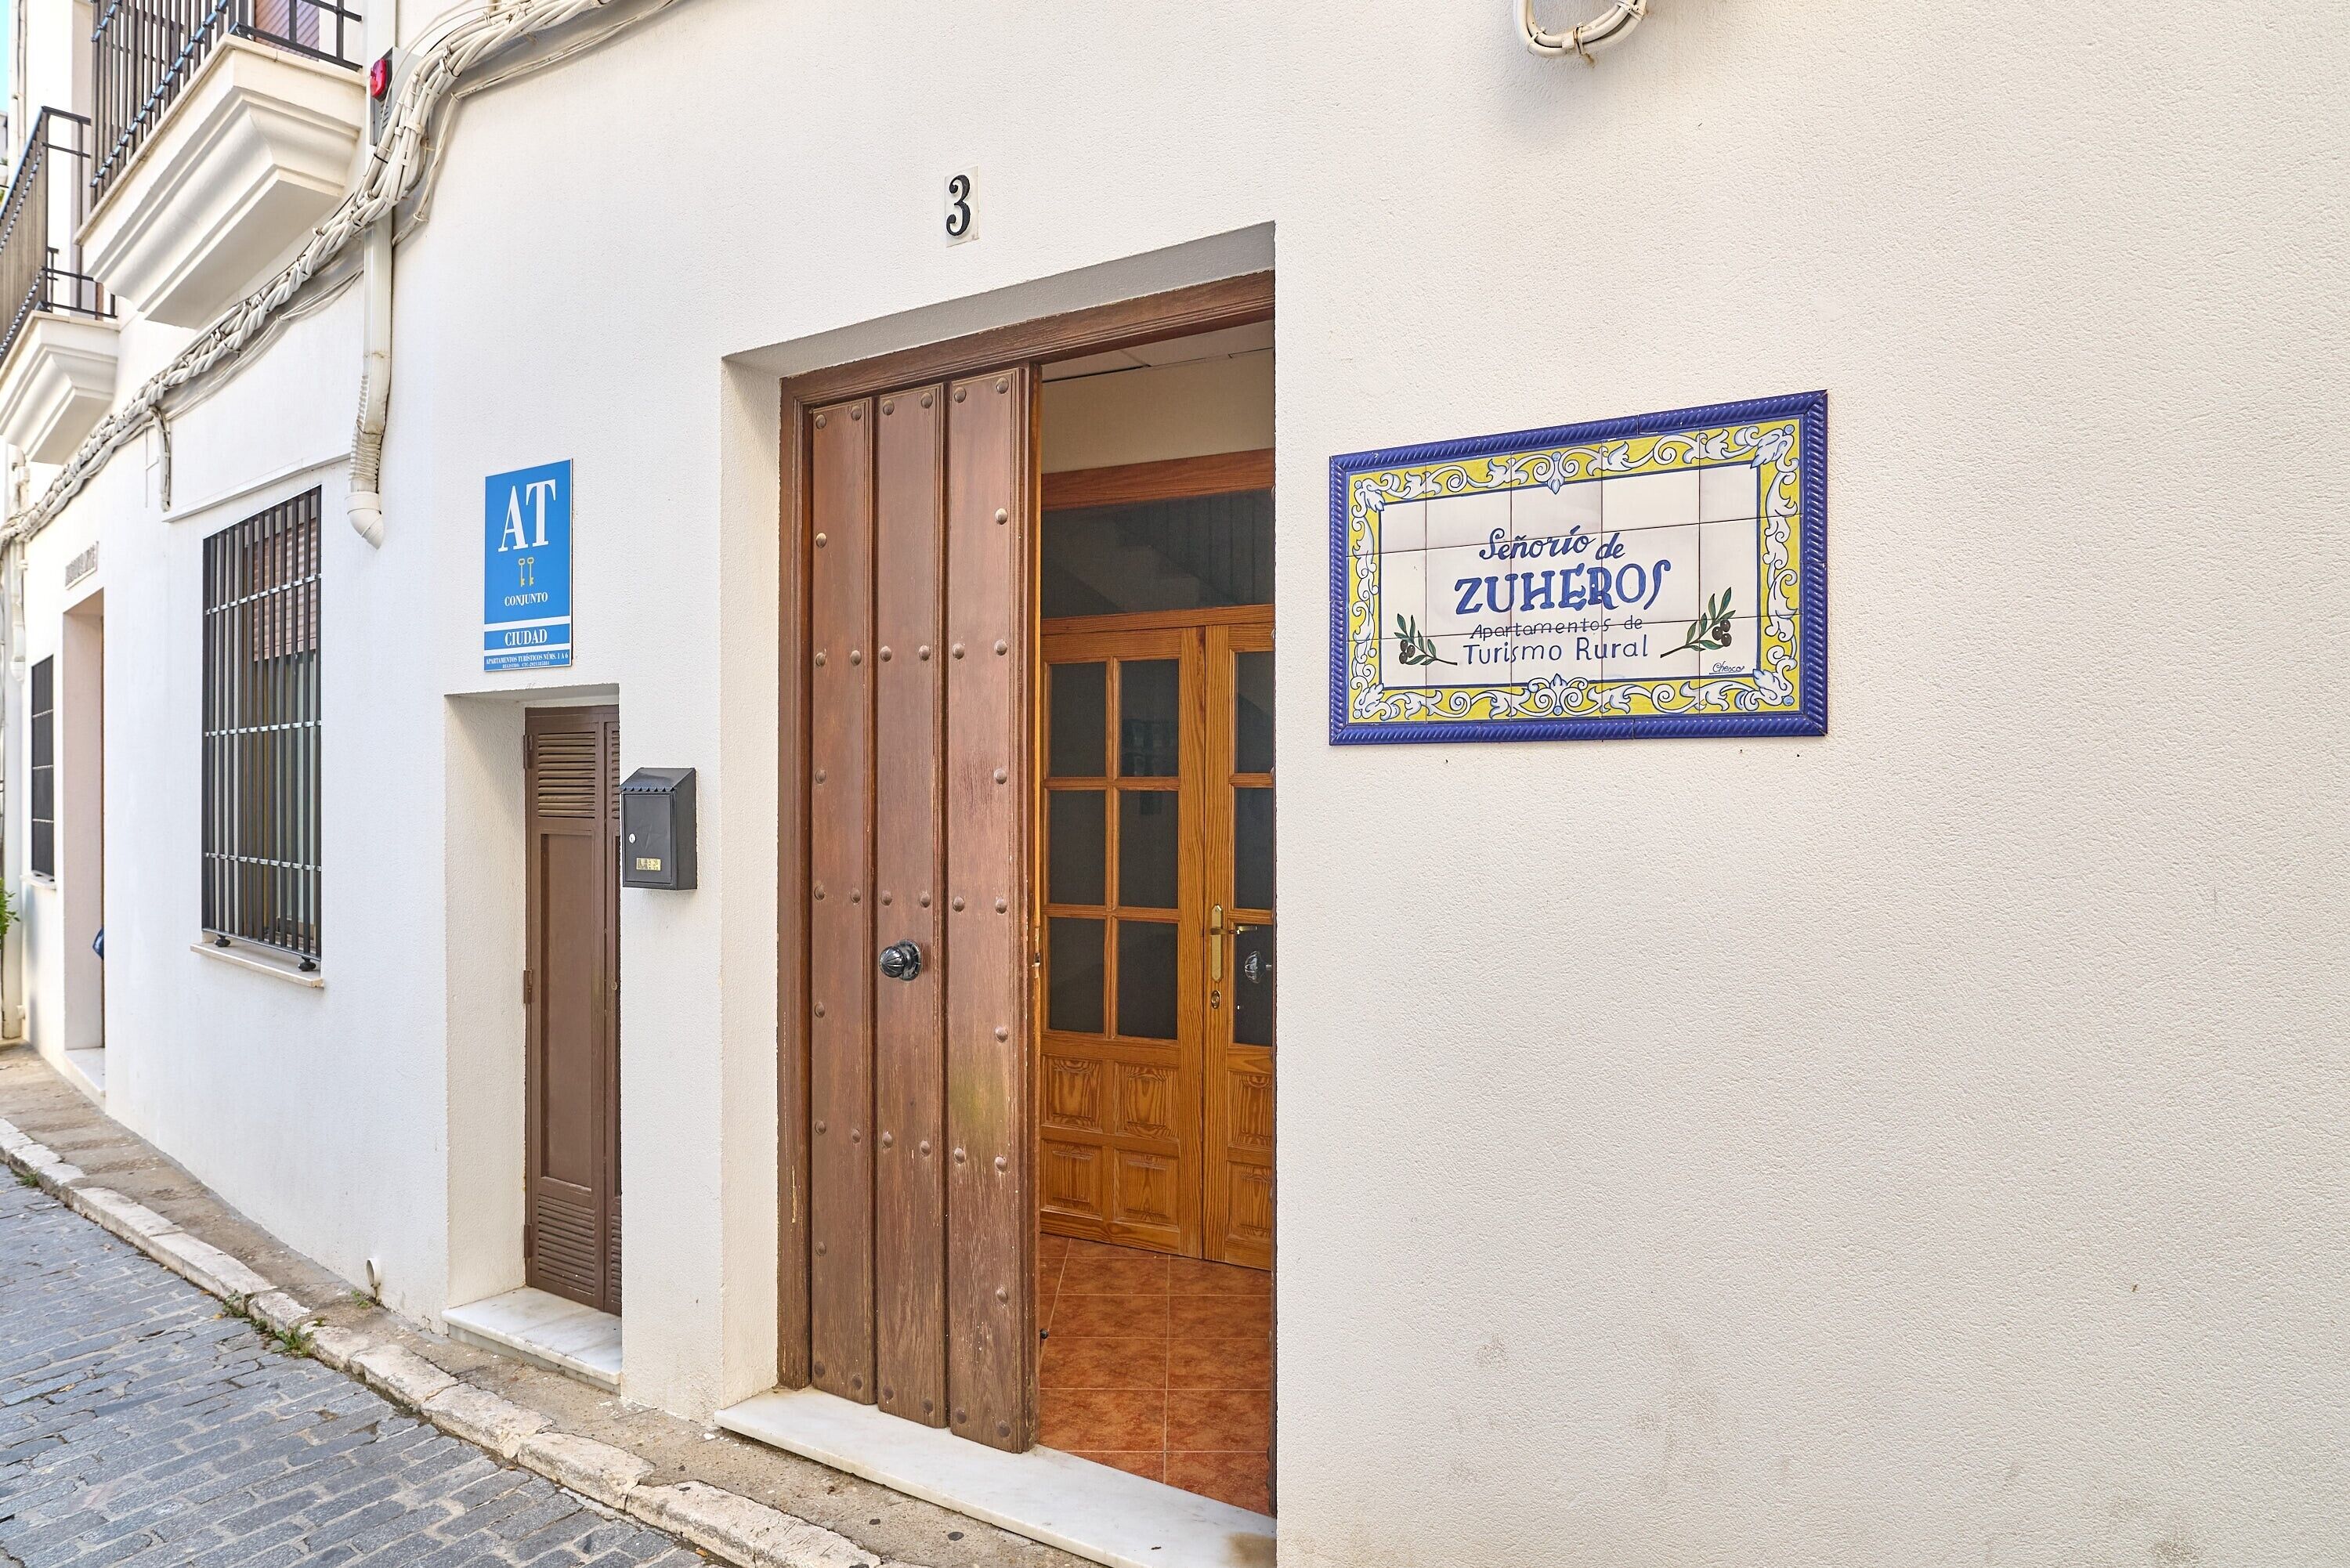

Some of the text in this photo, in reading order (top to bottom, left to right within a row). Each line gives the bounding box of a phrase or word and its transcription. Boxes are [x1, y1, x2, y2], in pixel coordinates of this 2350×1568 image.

[946, 175, 971, 236] 3
[497, 479, 556, 552] AT
[1479, 525, 1626, 561] Señorío de
[504, 591, 548, 607] CONJUNTO
[1454, 558, 1672, 616] ZUHEROS
[504, 628, 548, 647] CIUDAD
[1470, 615, 1643, 640] Apartamentos de
[1462, 634, 1649, 666] Turismo Rural
